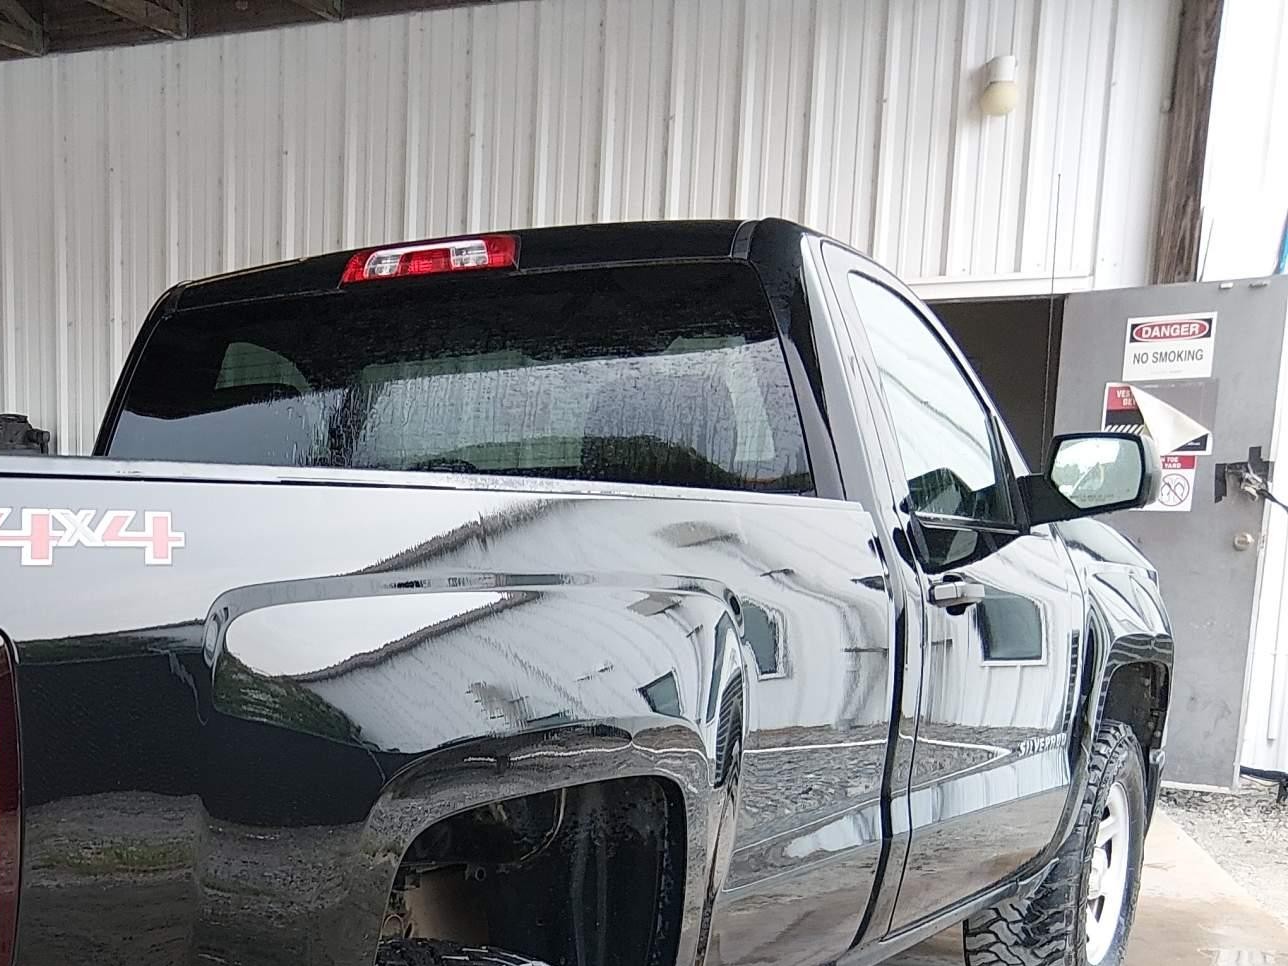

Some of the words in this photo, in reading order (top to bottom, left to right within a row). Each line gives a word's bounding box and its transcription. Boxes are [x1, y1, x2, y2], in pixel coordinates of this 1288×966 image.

[1141, 323, 1200, 338] DANGER
[1133, 352, 1149, 365] NO
[1152, 348, 1204, 364] SMOKING
[1116, 390, 1131, 398] VES
[1018, 732, 1067, 758] SILVERADO
